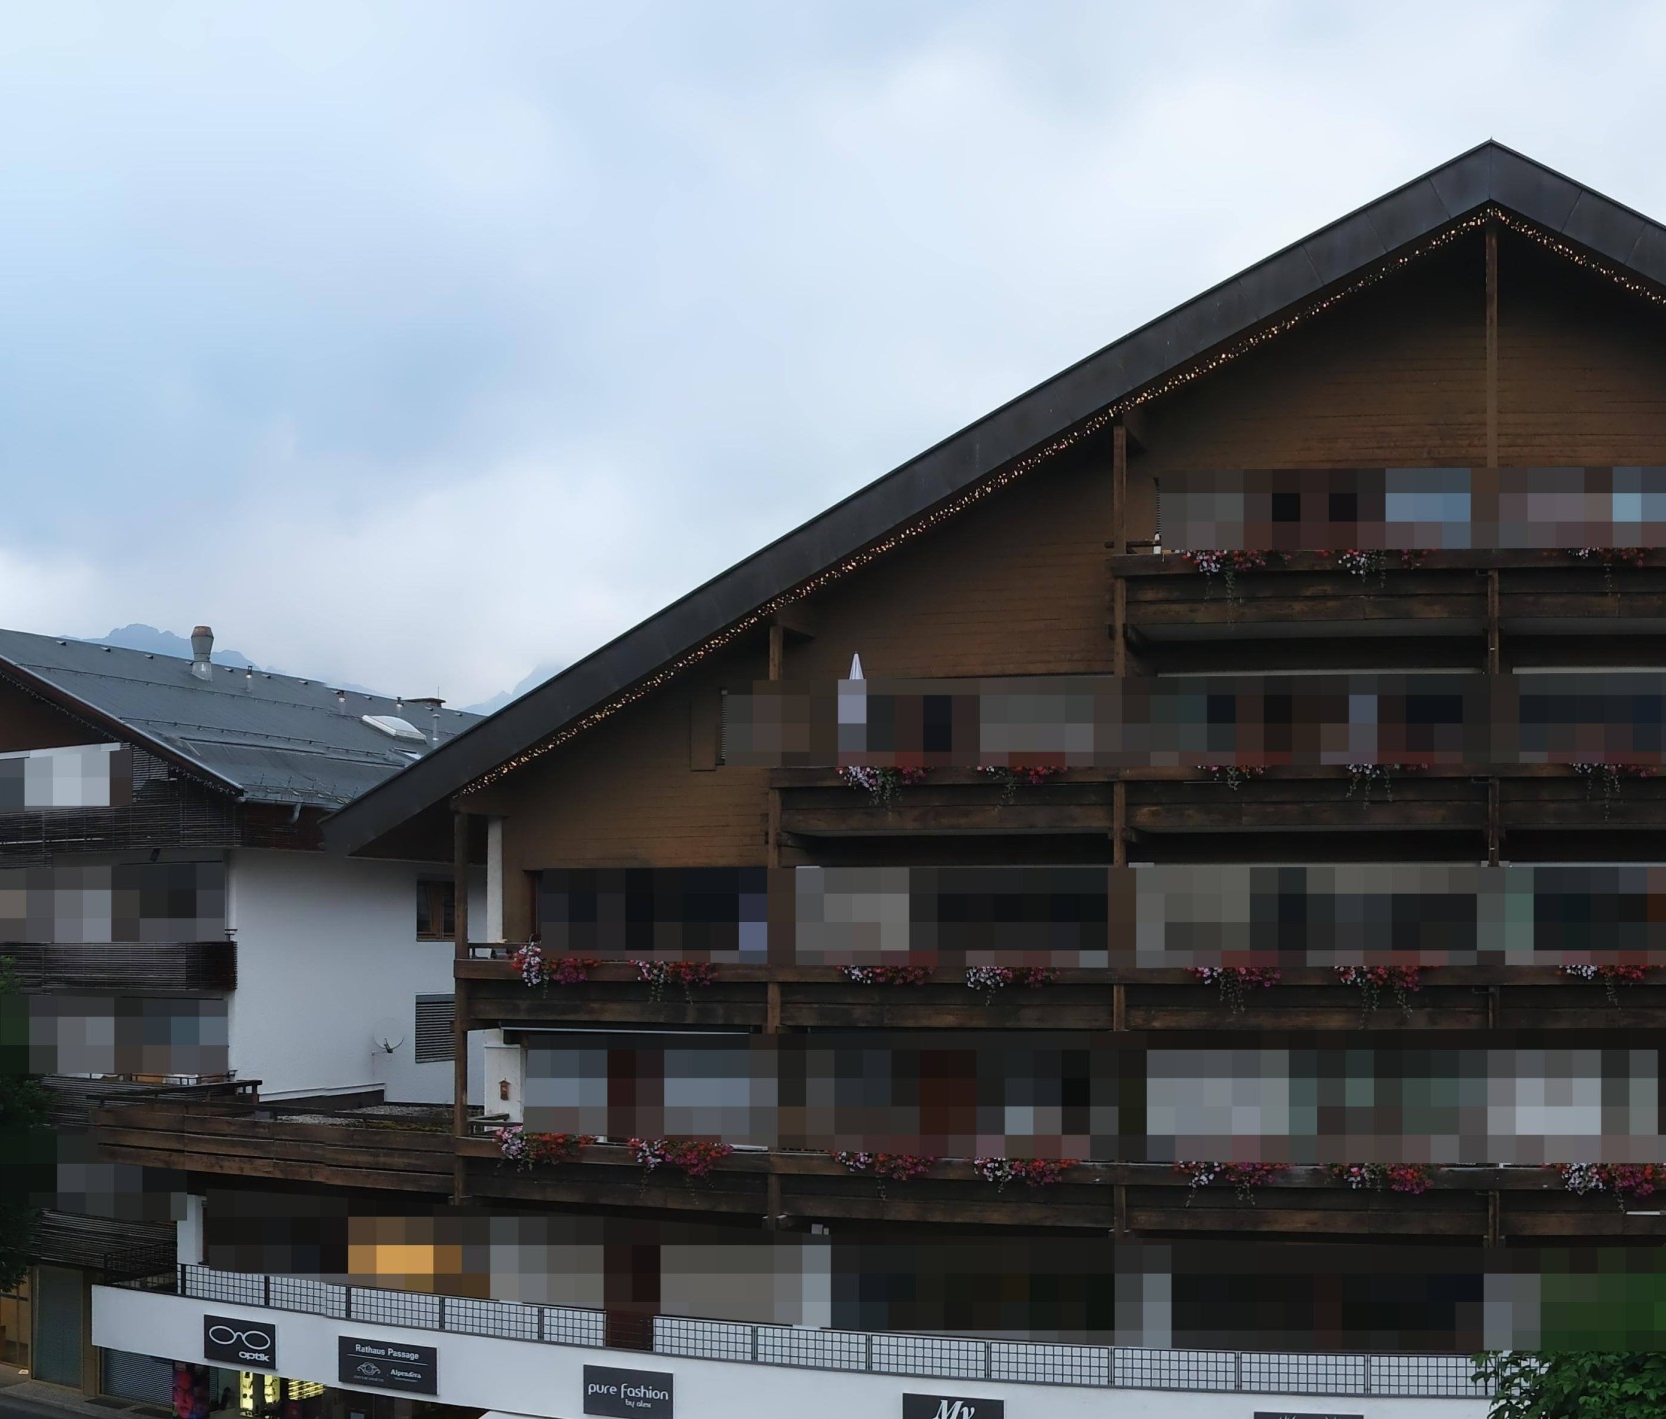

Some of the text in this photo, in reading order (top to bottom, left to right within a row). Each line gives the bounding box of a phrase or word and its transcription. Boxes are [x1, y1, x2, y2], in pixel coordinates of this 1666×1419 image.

[238, 1351, 270, 1362] optik
[355, 1344, 420, 1361] Rathaus Passage
[588, 1383, 669, 1400] pure fashion
